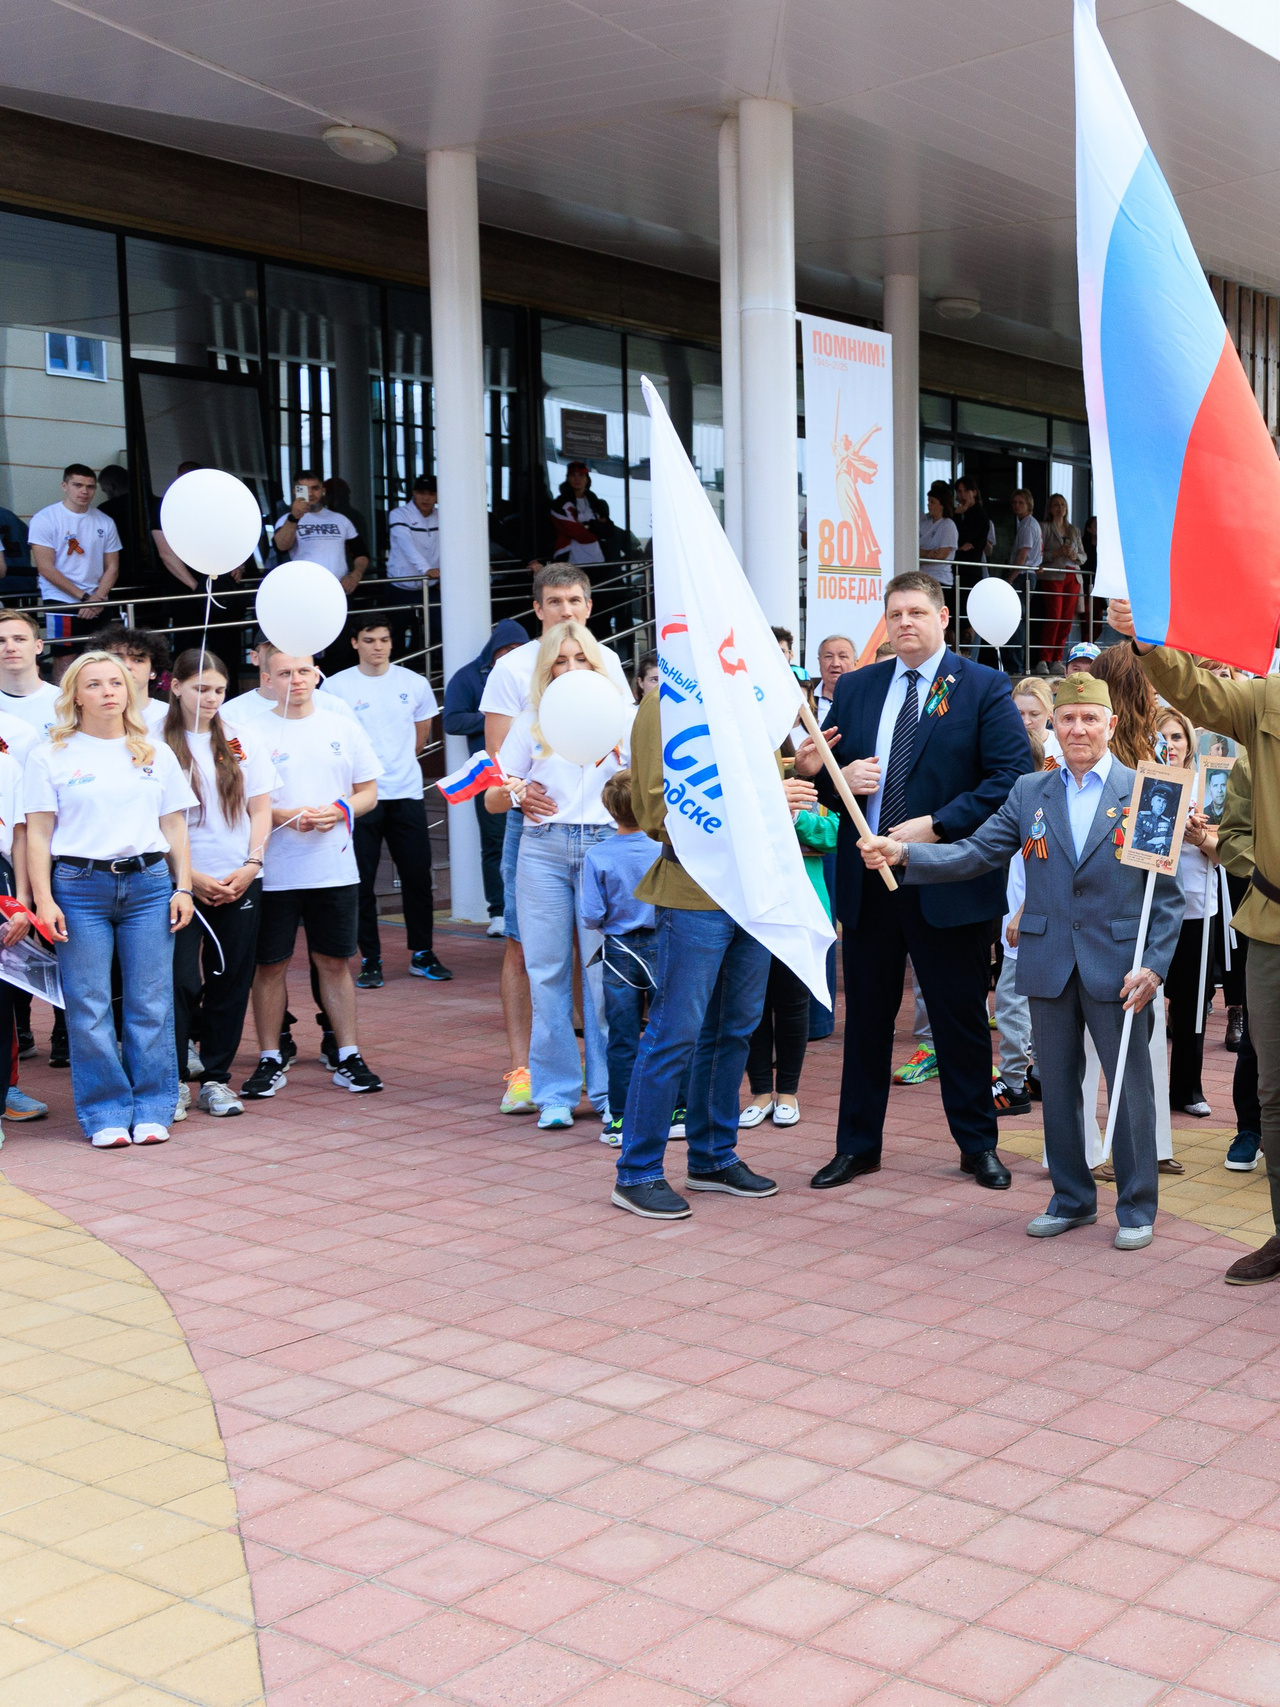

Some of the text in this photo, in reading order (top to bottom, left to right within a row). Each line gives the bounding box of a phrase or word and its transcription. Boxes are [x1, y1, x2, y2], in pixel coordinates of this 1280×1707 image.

[812, 330, 885, 368] ПОМНИМ!
[818, 519, 857, 567] 80
[817, 575, 882, 604] ПОБЕДА!
